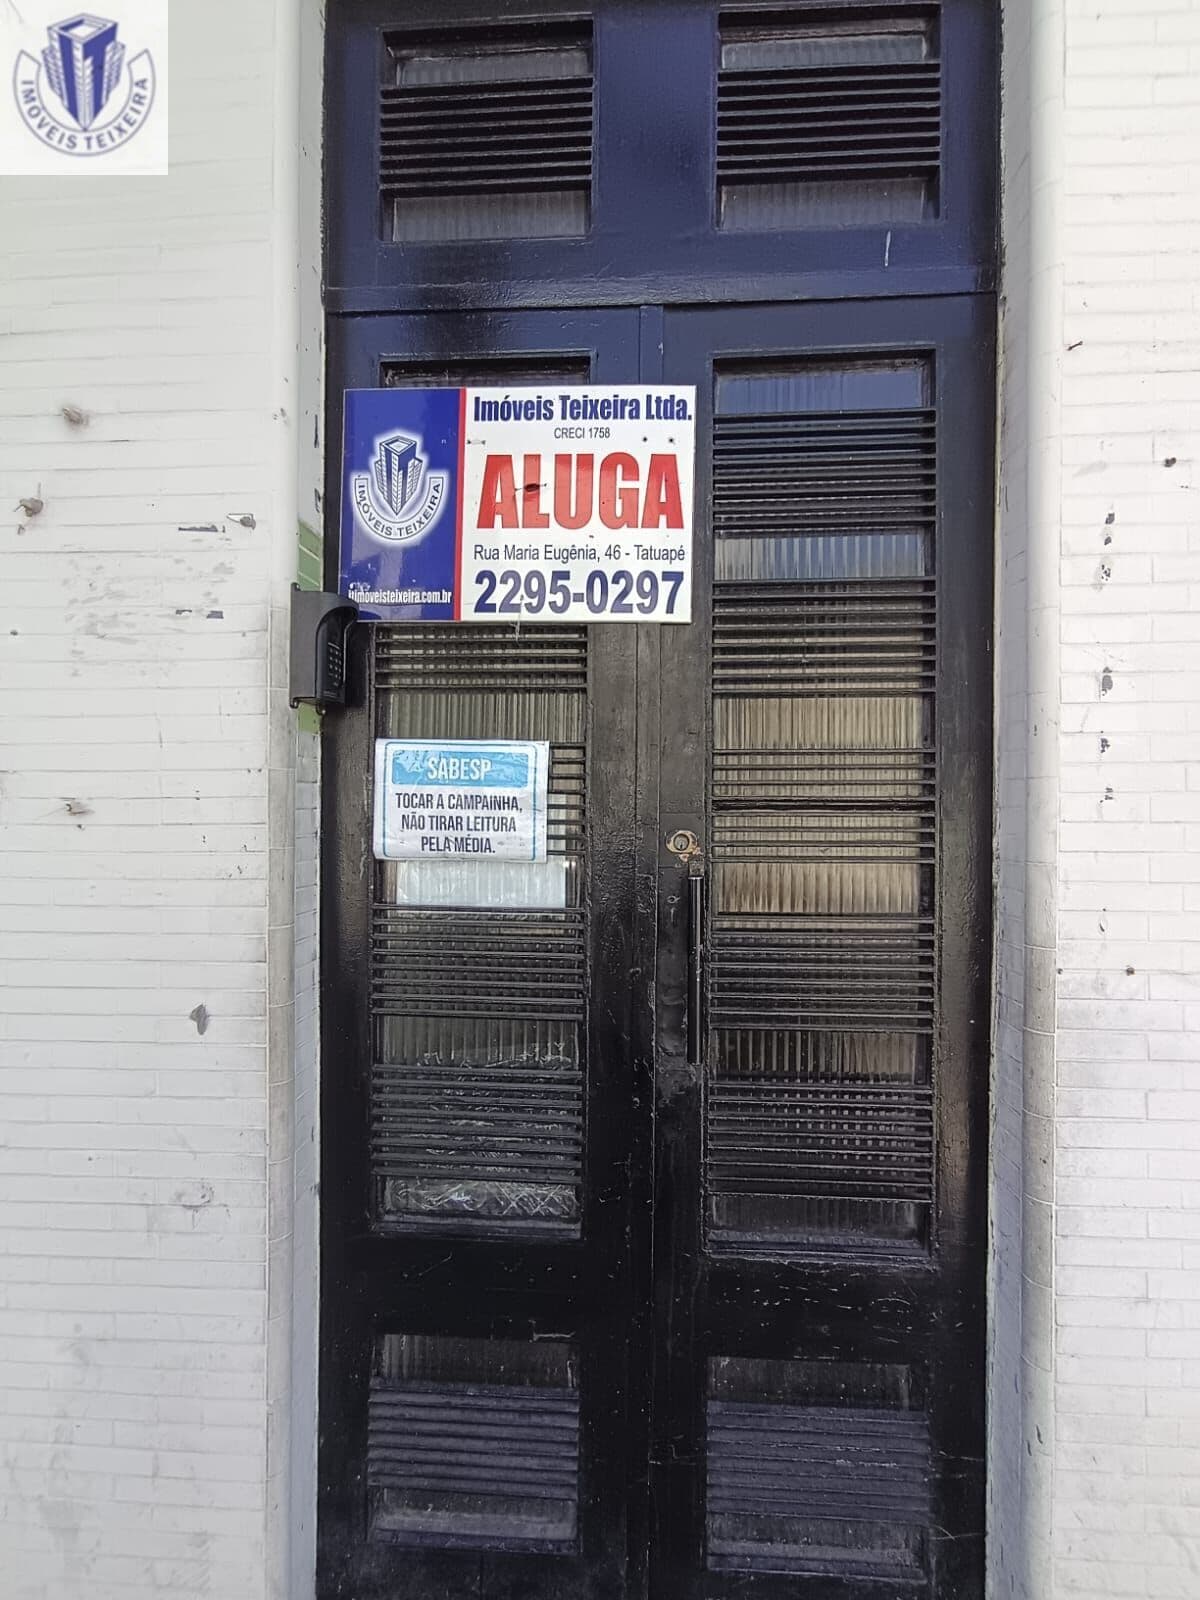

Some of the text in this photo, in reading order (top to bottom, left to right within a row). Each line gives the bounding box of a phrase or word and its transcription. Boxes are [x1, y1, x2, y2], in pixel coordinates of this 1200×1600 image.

[474, 394, 692, 422] Imóveis Teixeira Ltda.
[554, 427, 611, 439] CRECI 1758
[477, 452, 684, 530] ALUGA
[397, 483, 440, 537] TEIXEIRA
[474, 545, 500, 561] Rua
[504, 545, 540, 560] Maria
[544, 544, 601, 564] Eugênia,
[604, 545, 621, 560] 46
[634, 544, 685, 564] Tatuapé
[474, 569, 684, 614] 2295-0297
[427, 757, 491, 781] SABESP
[395, 792, 523, 812] TOCAR A CAMPAINHA,
[401, 811, 516, 832] NÃO TIRAR LEITURA
[421, 834, 496, 854] PELA MÉDIA.
